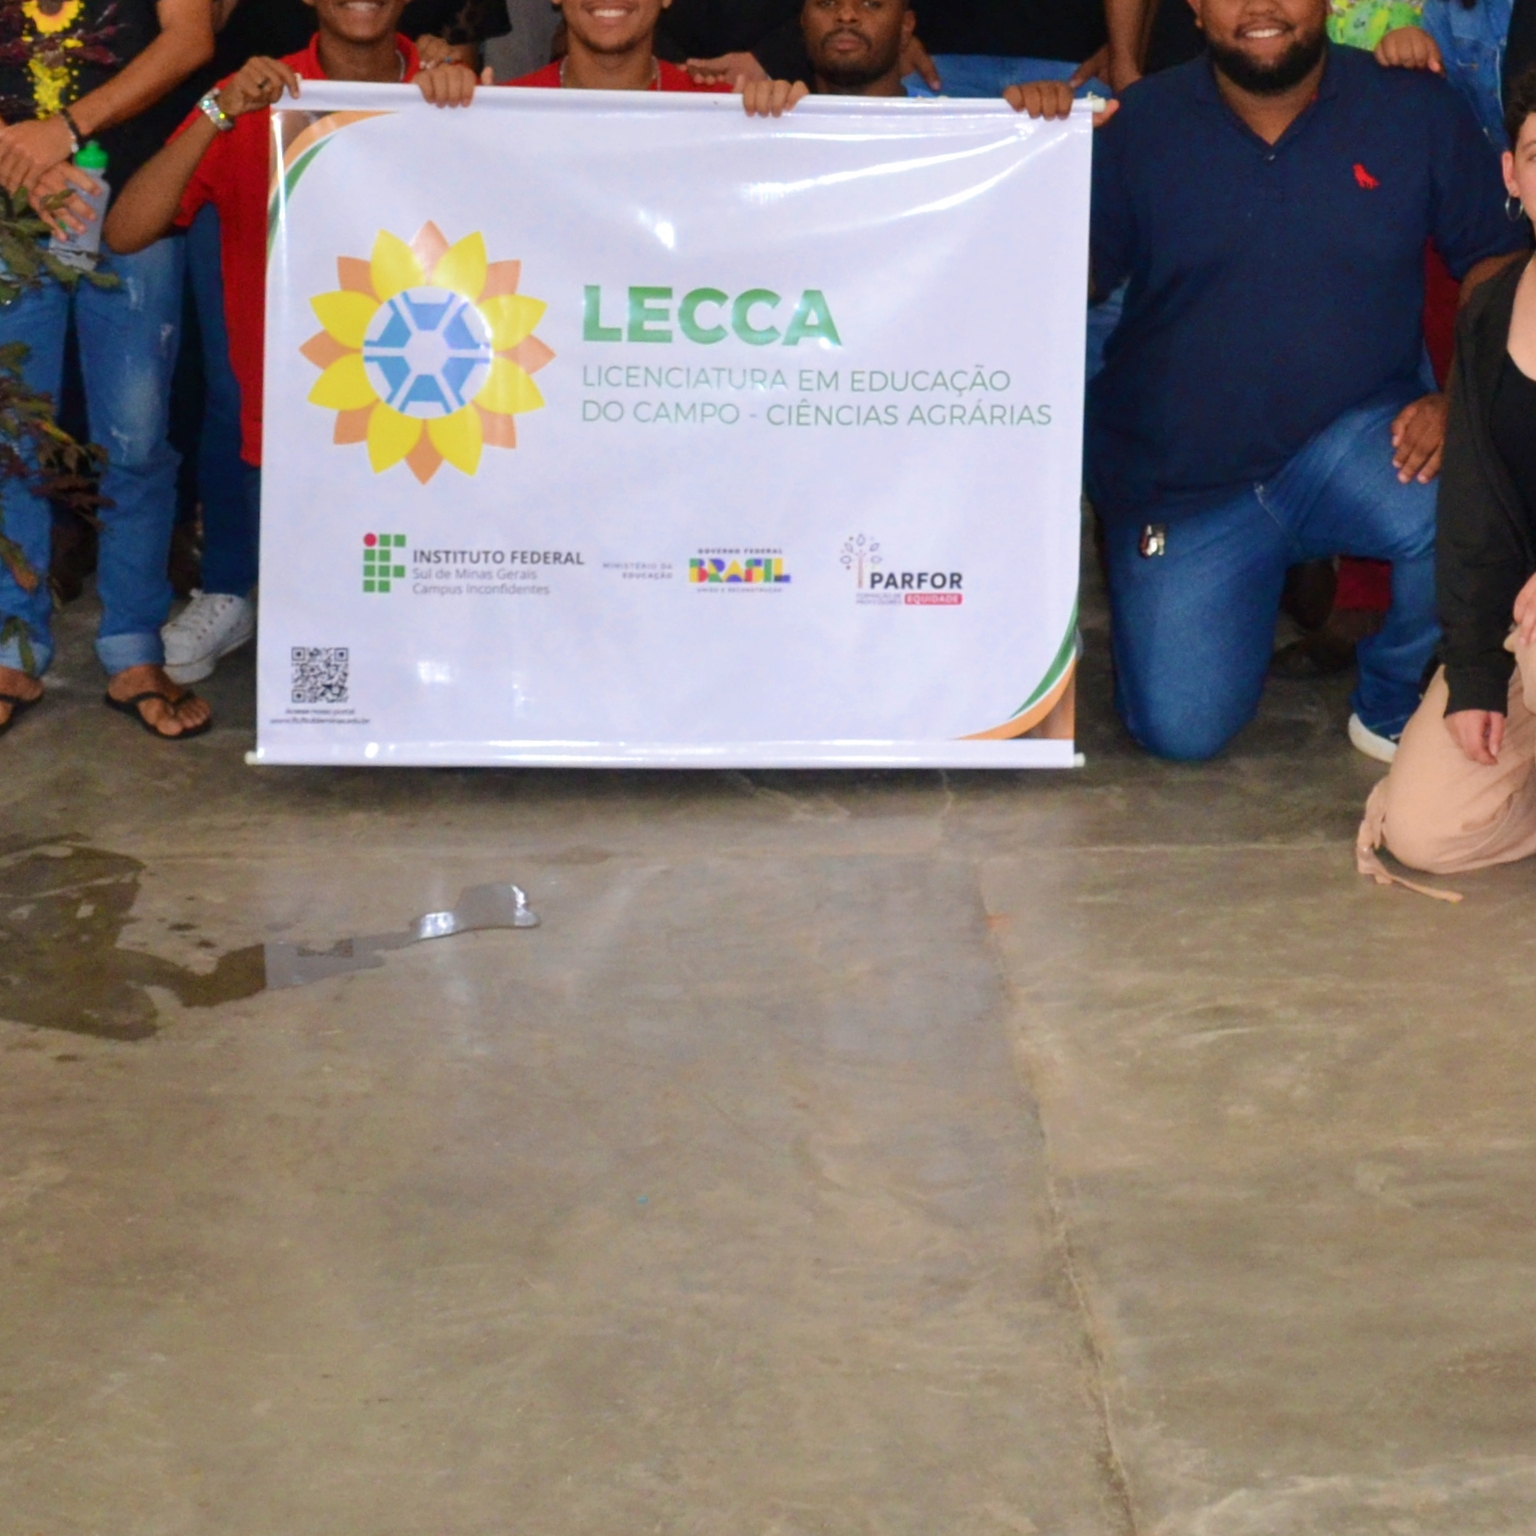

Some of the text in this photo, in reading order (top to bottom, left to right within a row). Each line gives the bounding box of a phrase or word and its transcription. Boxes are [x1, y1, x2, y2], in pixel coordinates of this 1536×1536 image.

[583, 284, 843, 347] LECCA
[582, 364, 1011, 398] LICENCIATURA EM EDUCAÇÃO
[582, 400, 624, 423] DO
[633, 401, 740, 425] CAMPO
[766, 400, 899, 426] CIÊNCIAS
[907, 399, 1052, 426] AGRÁRIAS
[413, 550, 584, 565] INSTITUTO FEDERAL
[413, 568, 537, 581] Sul de Minas Gerais
[689, 558, 791, 583] BRASIL
[870, 572, 963, 589] PARFOR
[413, 583, 550, 596] Campus Inconfidentes
[906, 594, 959, 604] EQUIDADE
